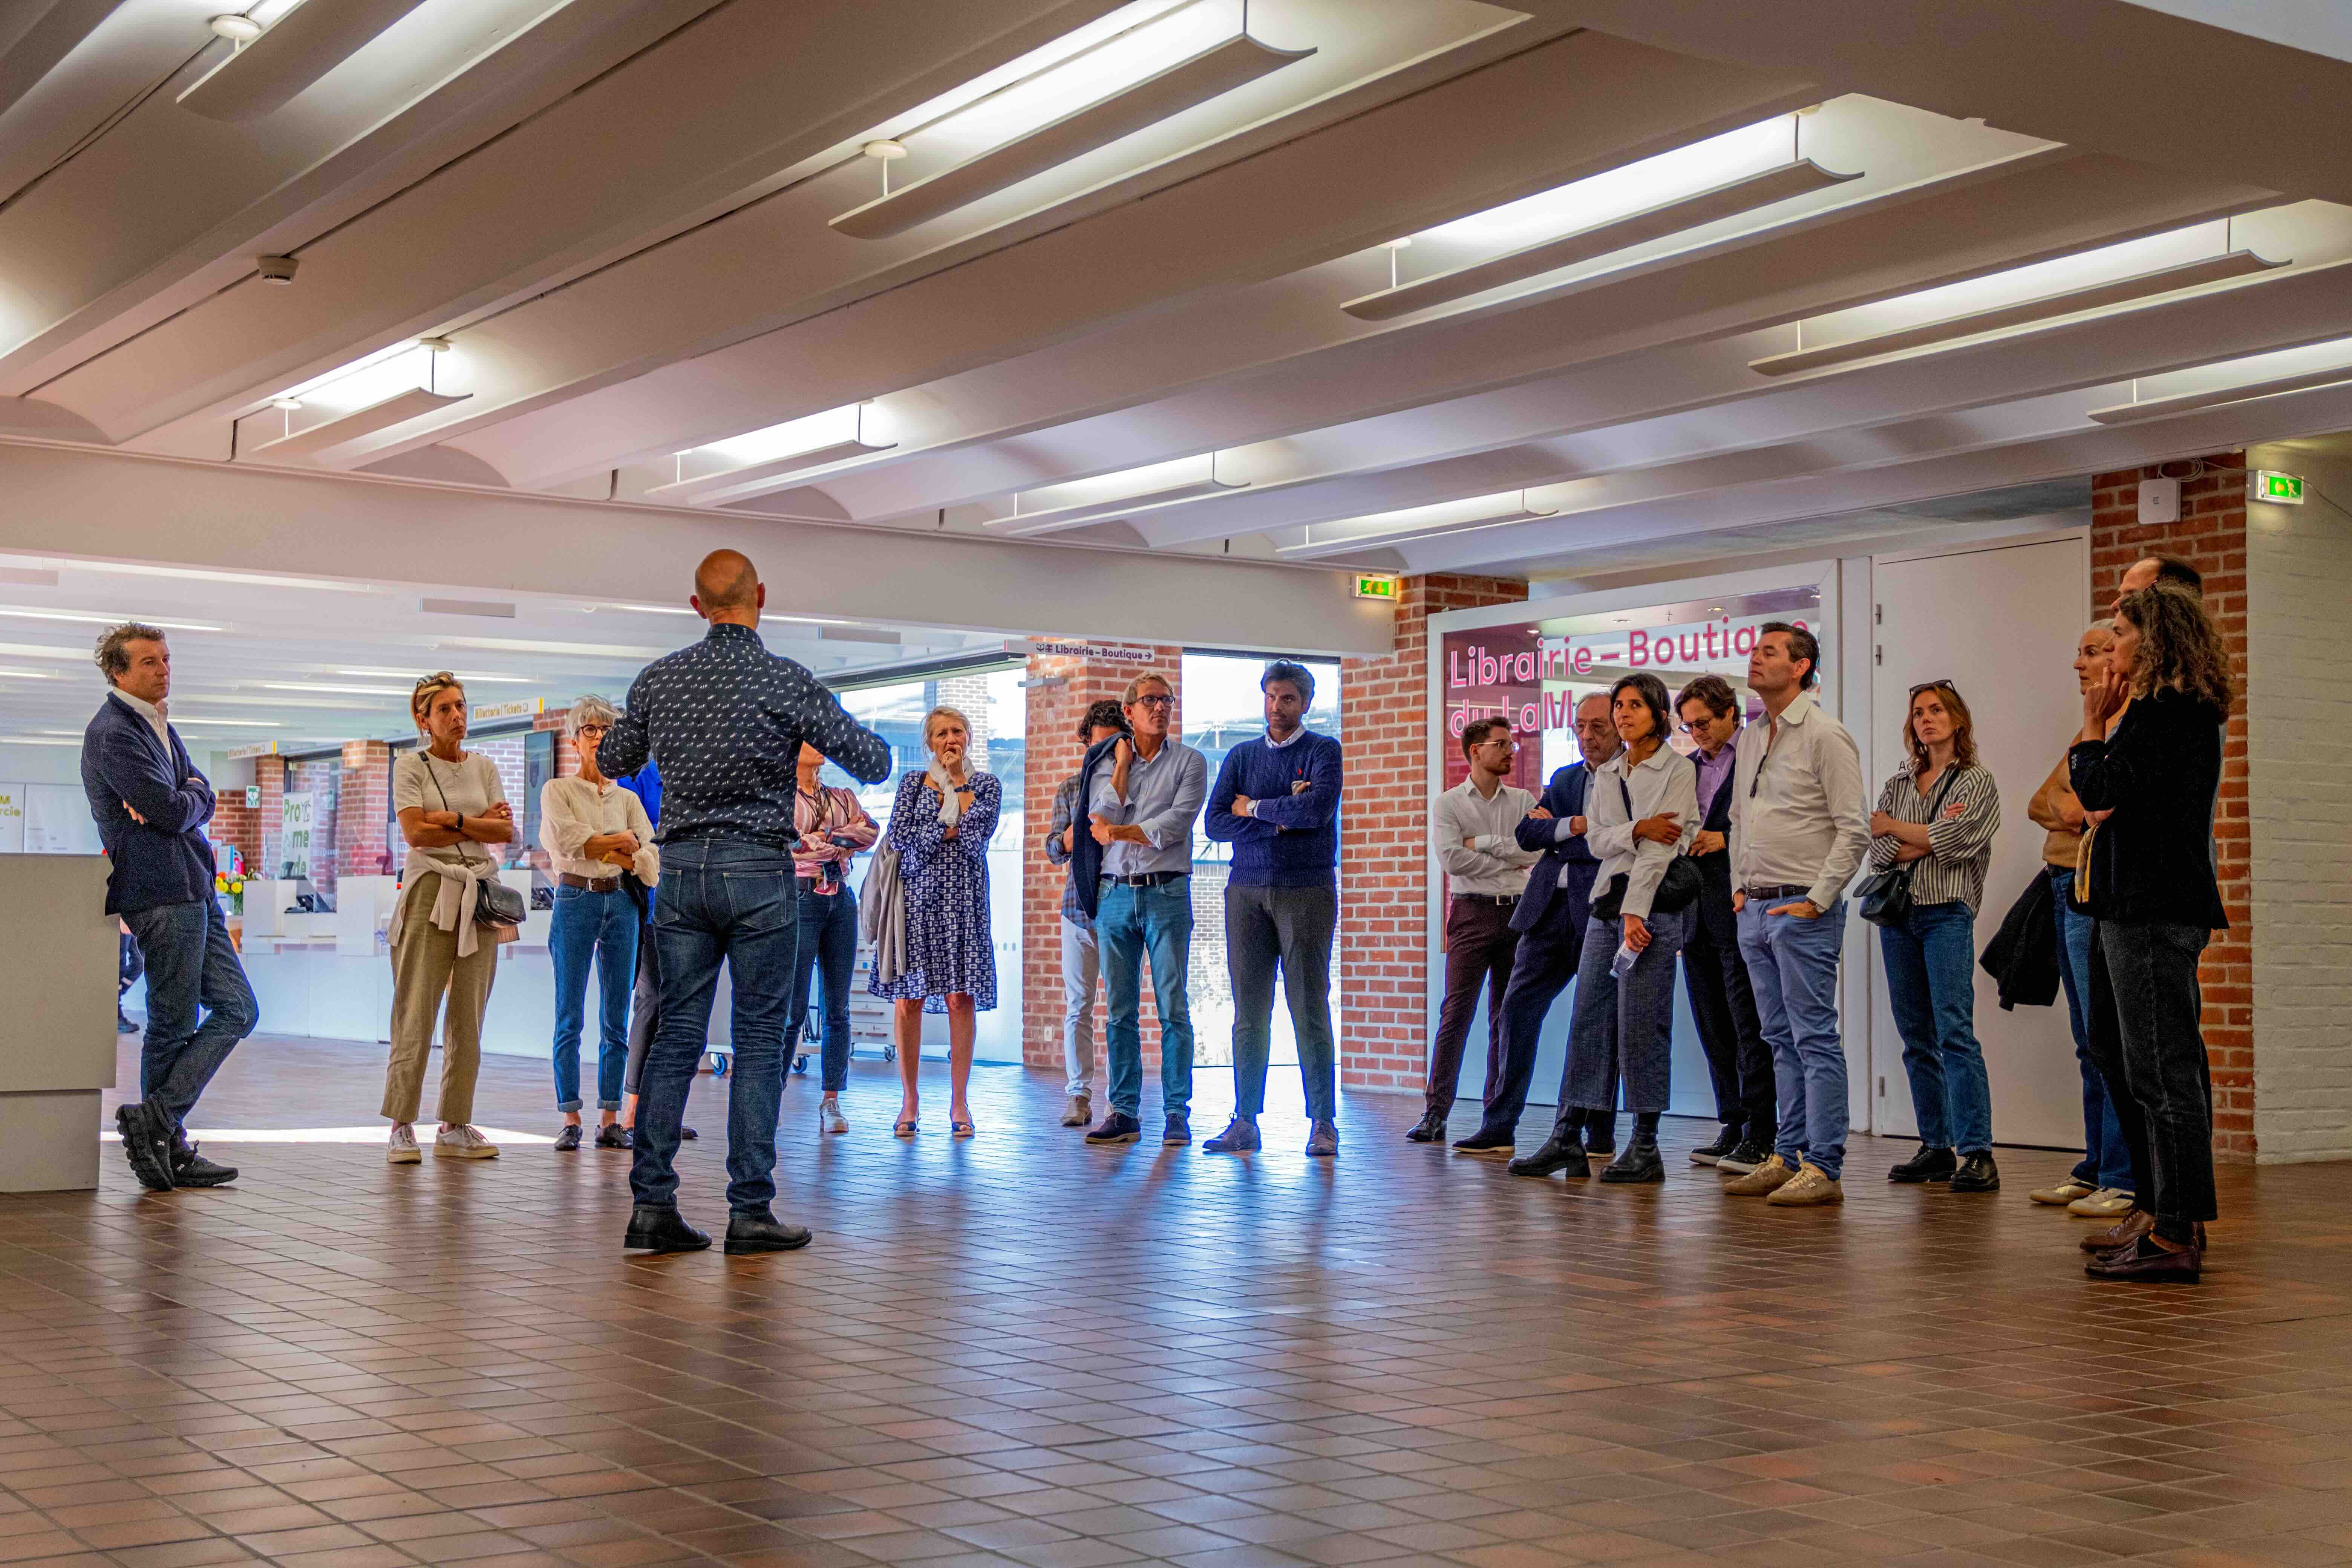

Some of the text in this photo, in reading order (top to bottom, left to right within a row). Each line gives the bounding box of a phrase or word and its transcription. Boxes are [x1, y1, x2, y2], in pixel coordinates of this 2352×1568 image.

[1102, 647, 1143, 660] Boutique
[1451, 637, 1592, 688] Librairie
[1502, 690, 1573, 733] LaM
[284, 799, 300, 822] Pro
[292, 830, 309, 848] me
